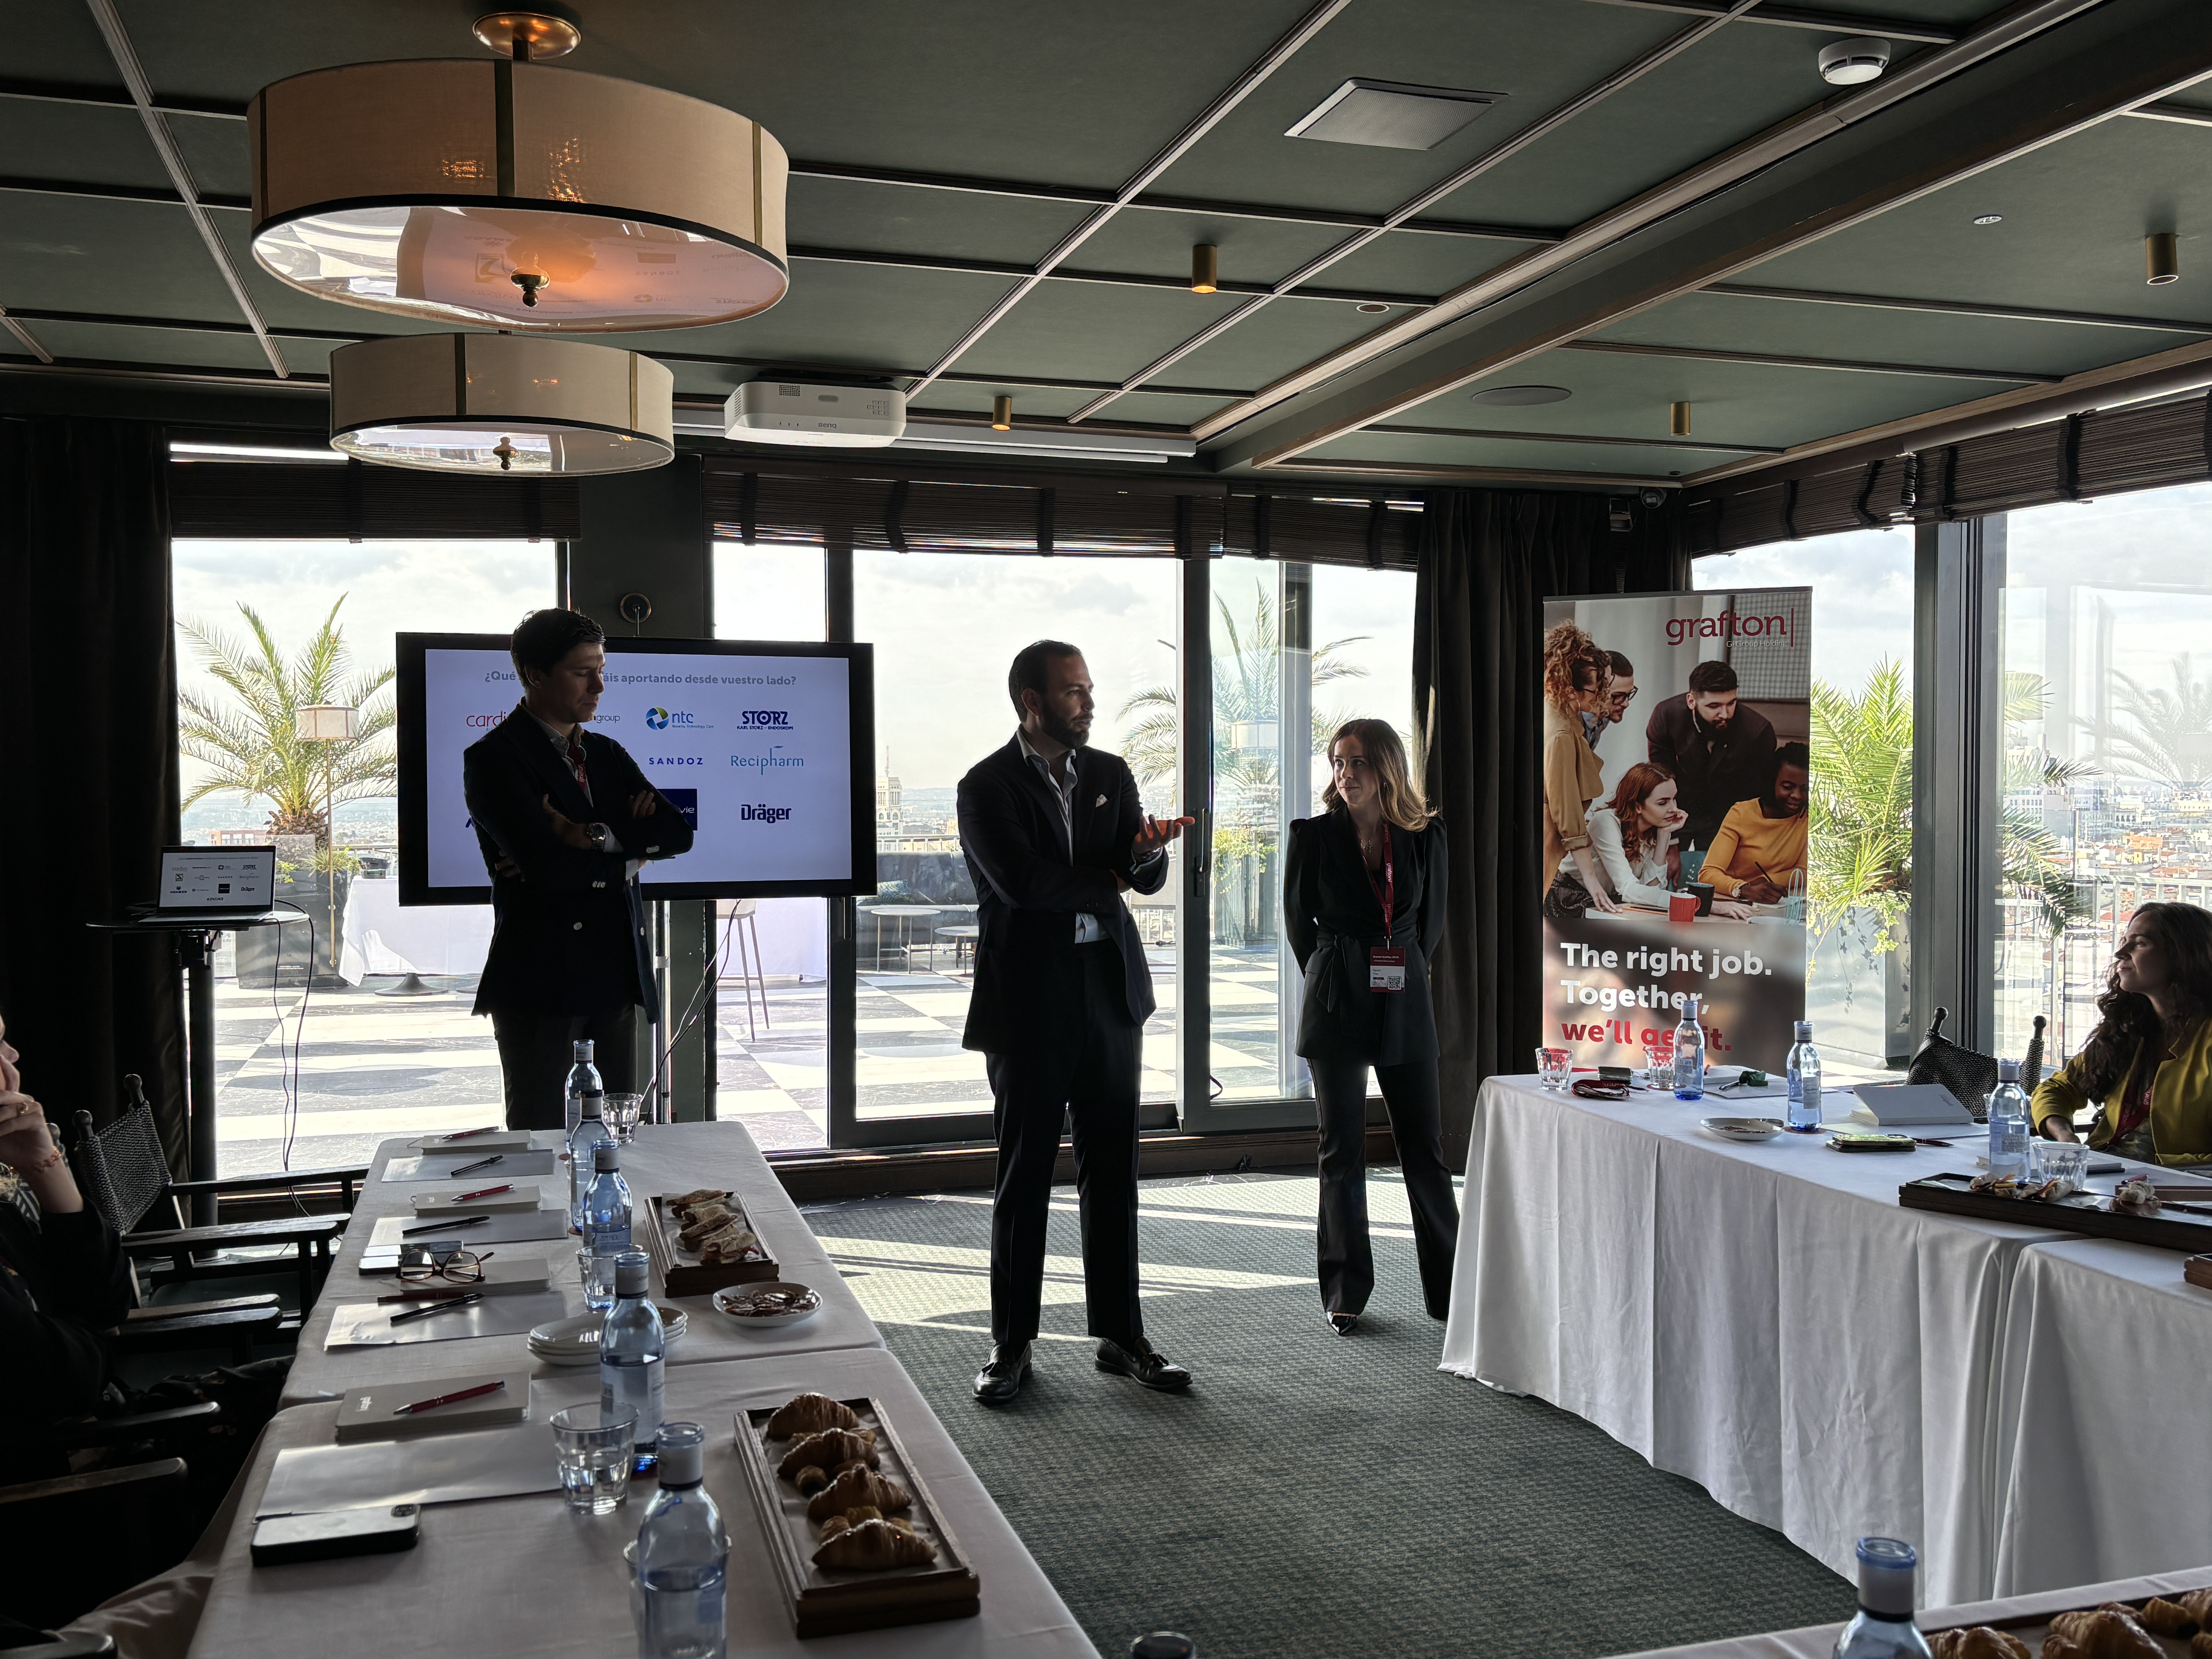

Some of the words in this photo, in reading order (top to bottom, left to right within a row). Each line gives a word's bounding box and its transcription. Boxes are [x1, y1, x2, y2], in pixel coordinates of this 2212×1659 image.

[1760, 640, 1787, 648] Holding
[485, 671, 516, 682] ¿Qué
[621, 674, 682, 685] aportando
[685, 674, 718, 684] desde
[721, 676, 764, 684] vuestro
[767, 676, 796, 685] lado?
[672, 711, 693, 723] ntc
[742, 710, 788, 725] STORZ
[731, 747, 804, 775] Recipharm
[741, 804, 792, 823] Dräger
[1560, 943, 1618, 968] The
[1627, 946, 1703, 977] right
[1709, 949, 1771, 979] job.
[1560, 980, 1709, 1015] Together,
[1641, 1028, 1675, 1052] ge
[1704, 1026, 1731, 1051] it.
